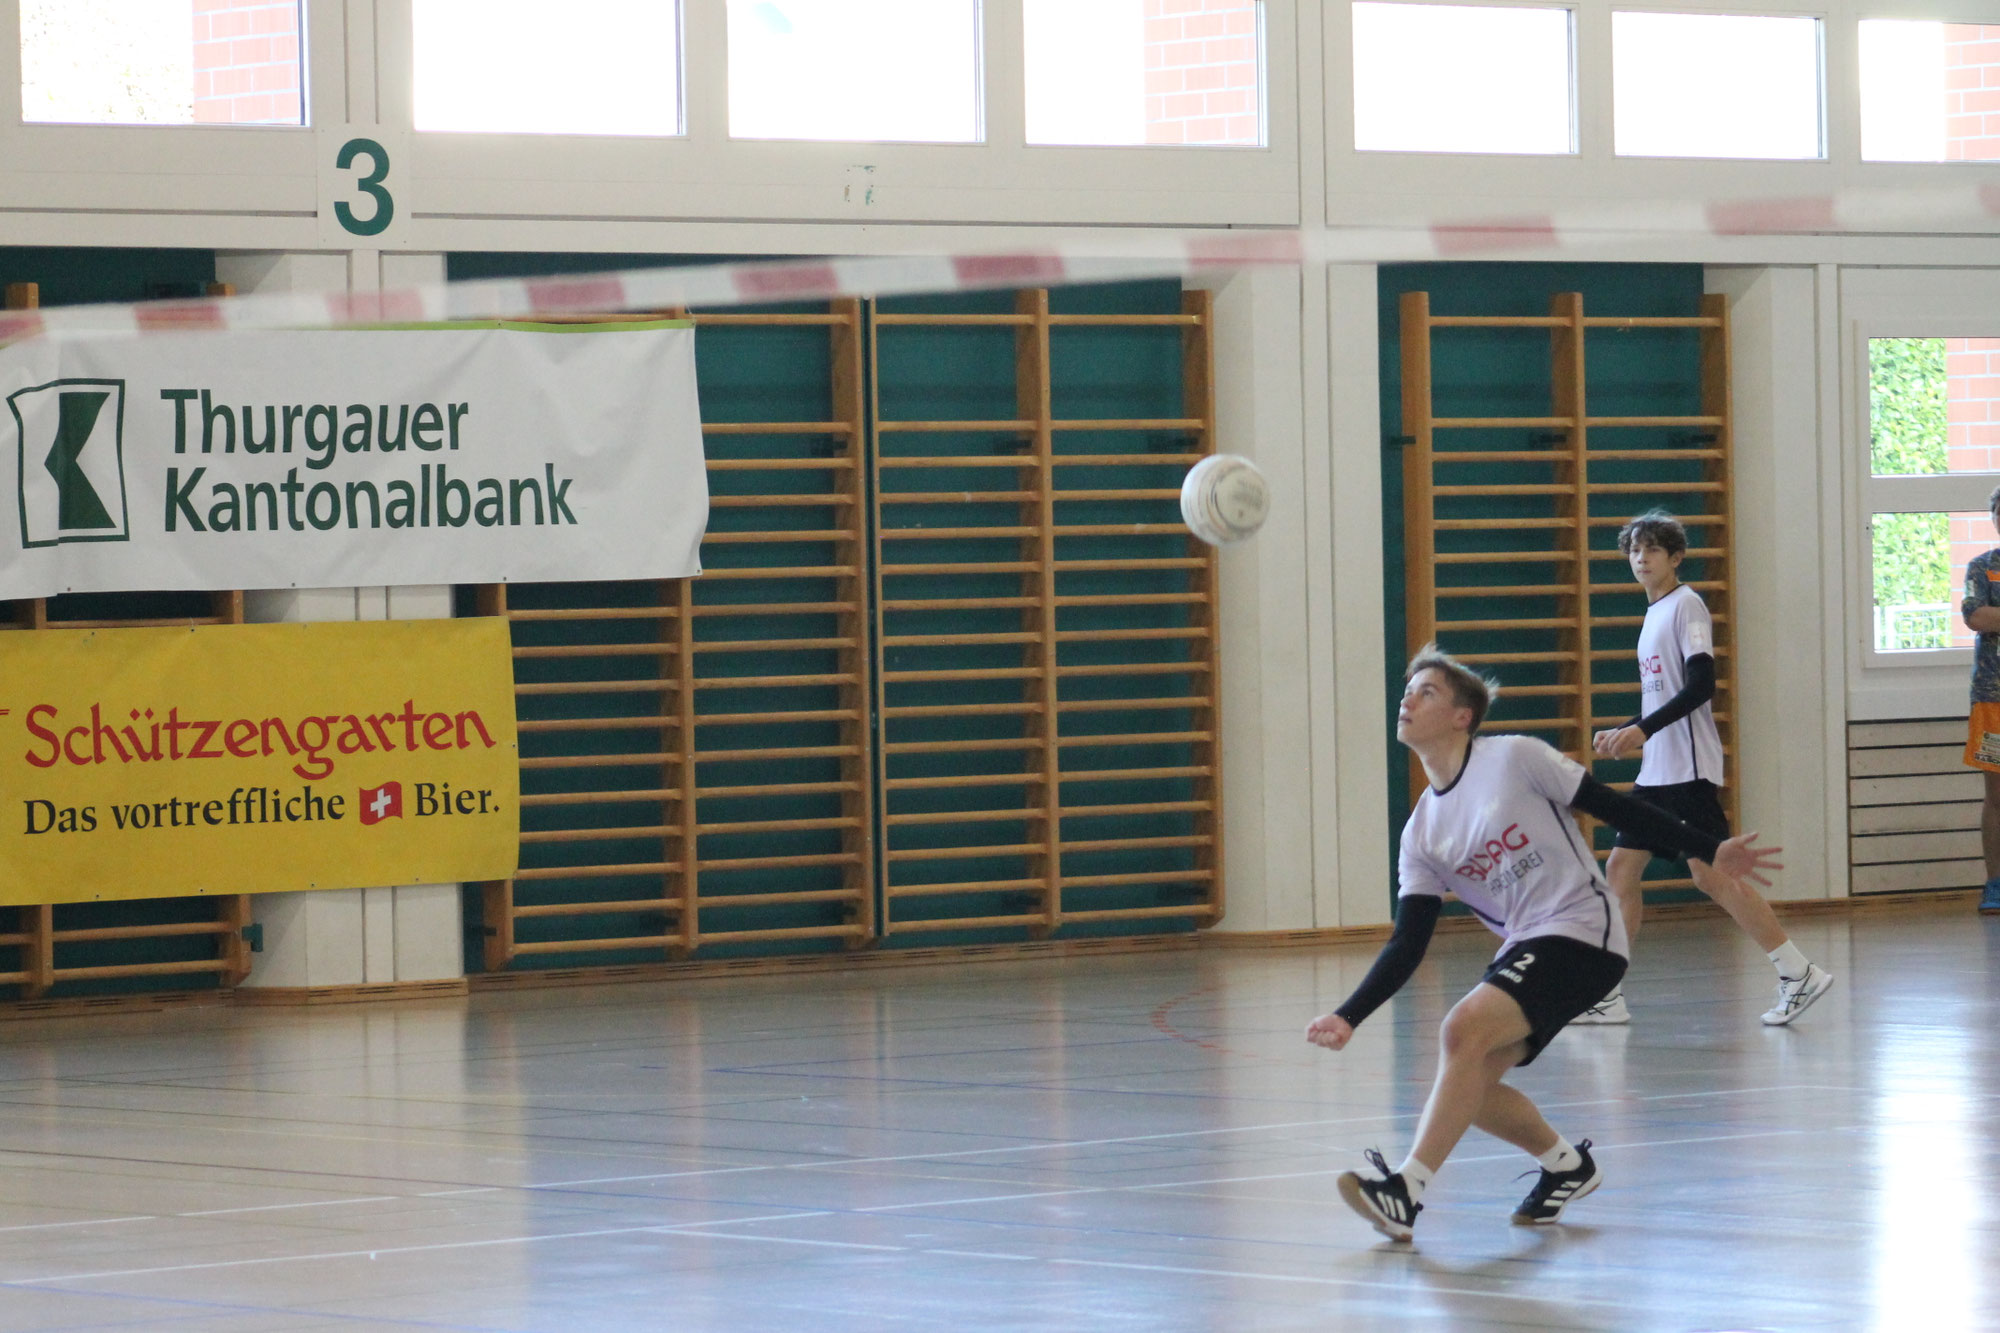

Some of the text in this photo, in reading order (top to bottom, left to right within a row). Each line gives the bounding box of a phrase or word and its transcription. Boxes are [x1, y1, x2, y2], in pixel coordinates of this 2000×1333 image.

[334, 138, 394, 237] 3
[160, 388, 469, 470] Thurgauer
[164, 462, 578, 533] Kantonalbank
[25, 700, 497, 780] Schützengarten
[23, 782, 500, 835] Das vortreffliche Bier.
[1513, 952, 1535, 971] 2
